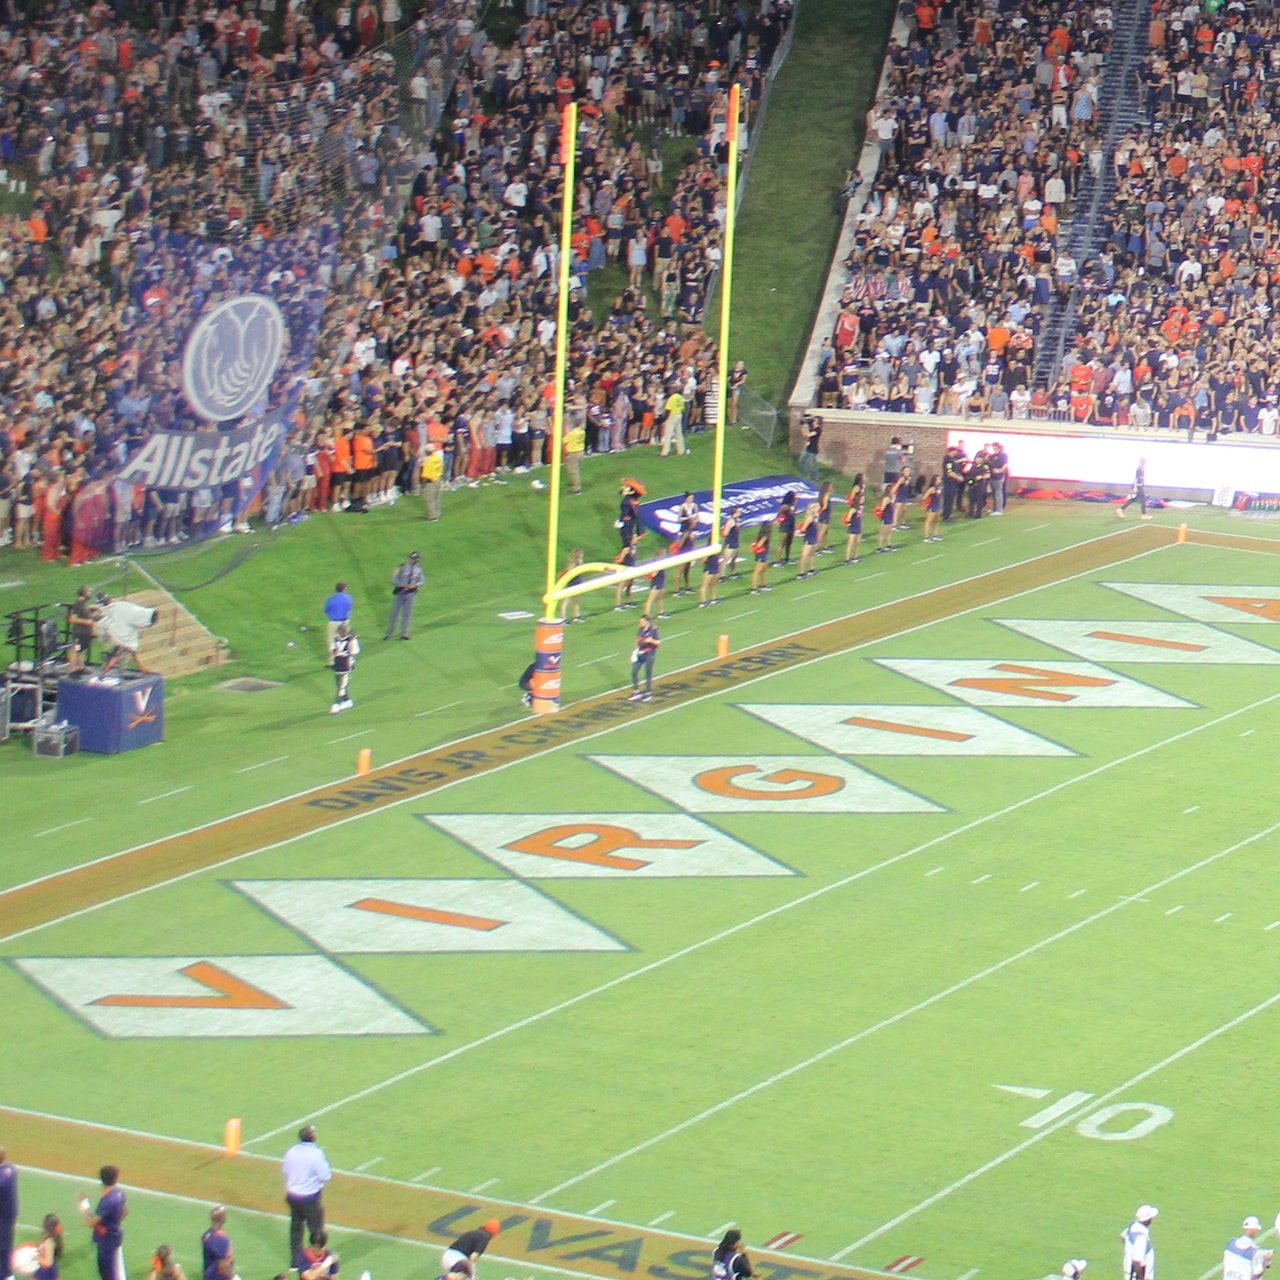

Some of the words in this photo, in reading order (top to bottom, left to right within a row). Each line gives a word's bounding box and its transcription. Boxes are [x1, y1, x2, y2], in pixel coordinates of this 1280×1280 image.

[116, 422, 280, 488] Allstate
[306, 757, 449, 813] DAVIS
[447, 747, 494, 772] JR
[712, 641, 820, 682] PERRY
[1018, 1090, 1176, 1142] 10
